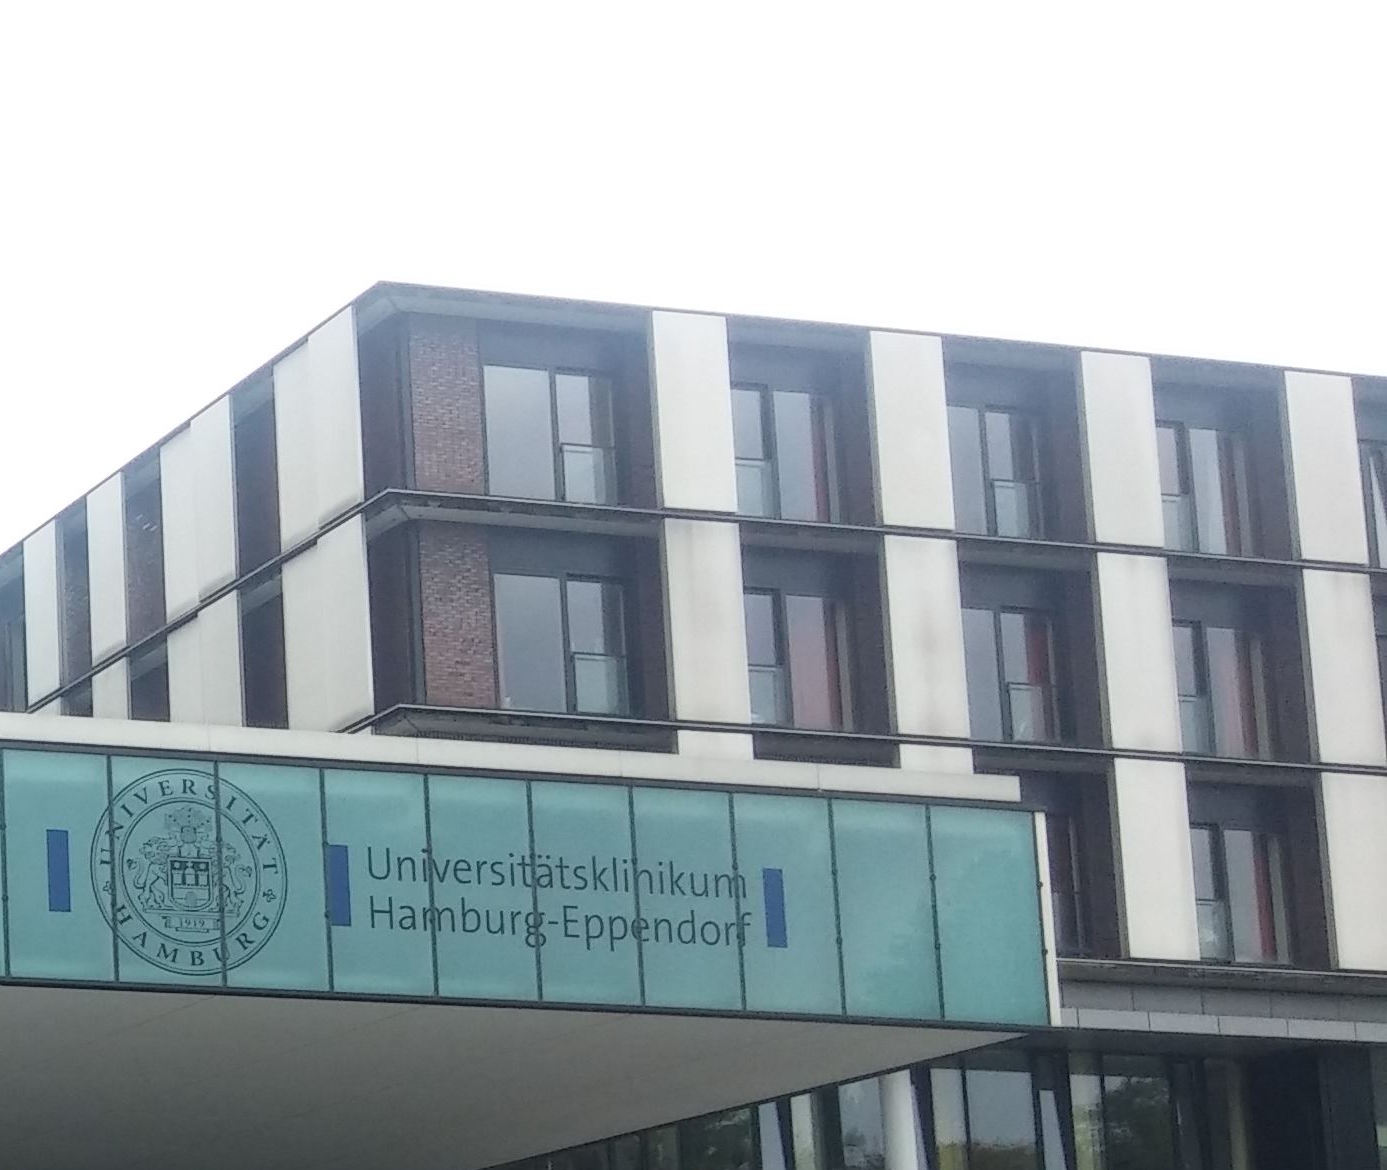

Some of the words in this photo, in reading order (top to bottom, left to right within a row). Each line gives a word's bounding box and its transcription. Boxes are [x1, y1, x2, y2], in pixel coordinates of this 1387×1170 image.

[366, 845, 748, 900] Universitätsklinikum
[115, 903, 270, 968] HAMBURG
[368, 895, 753, 953] Hamburg-Eppendorf
